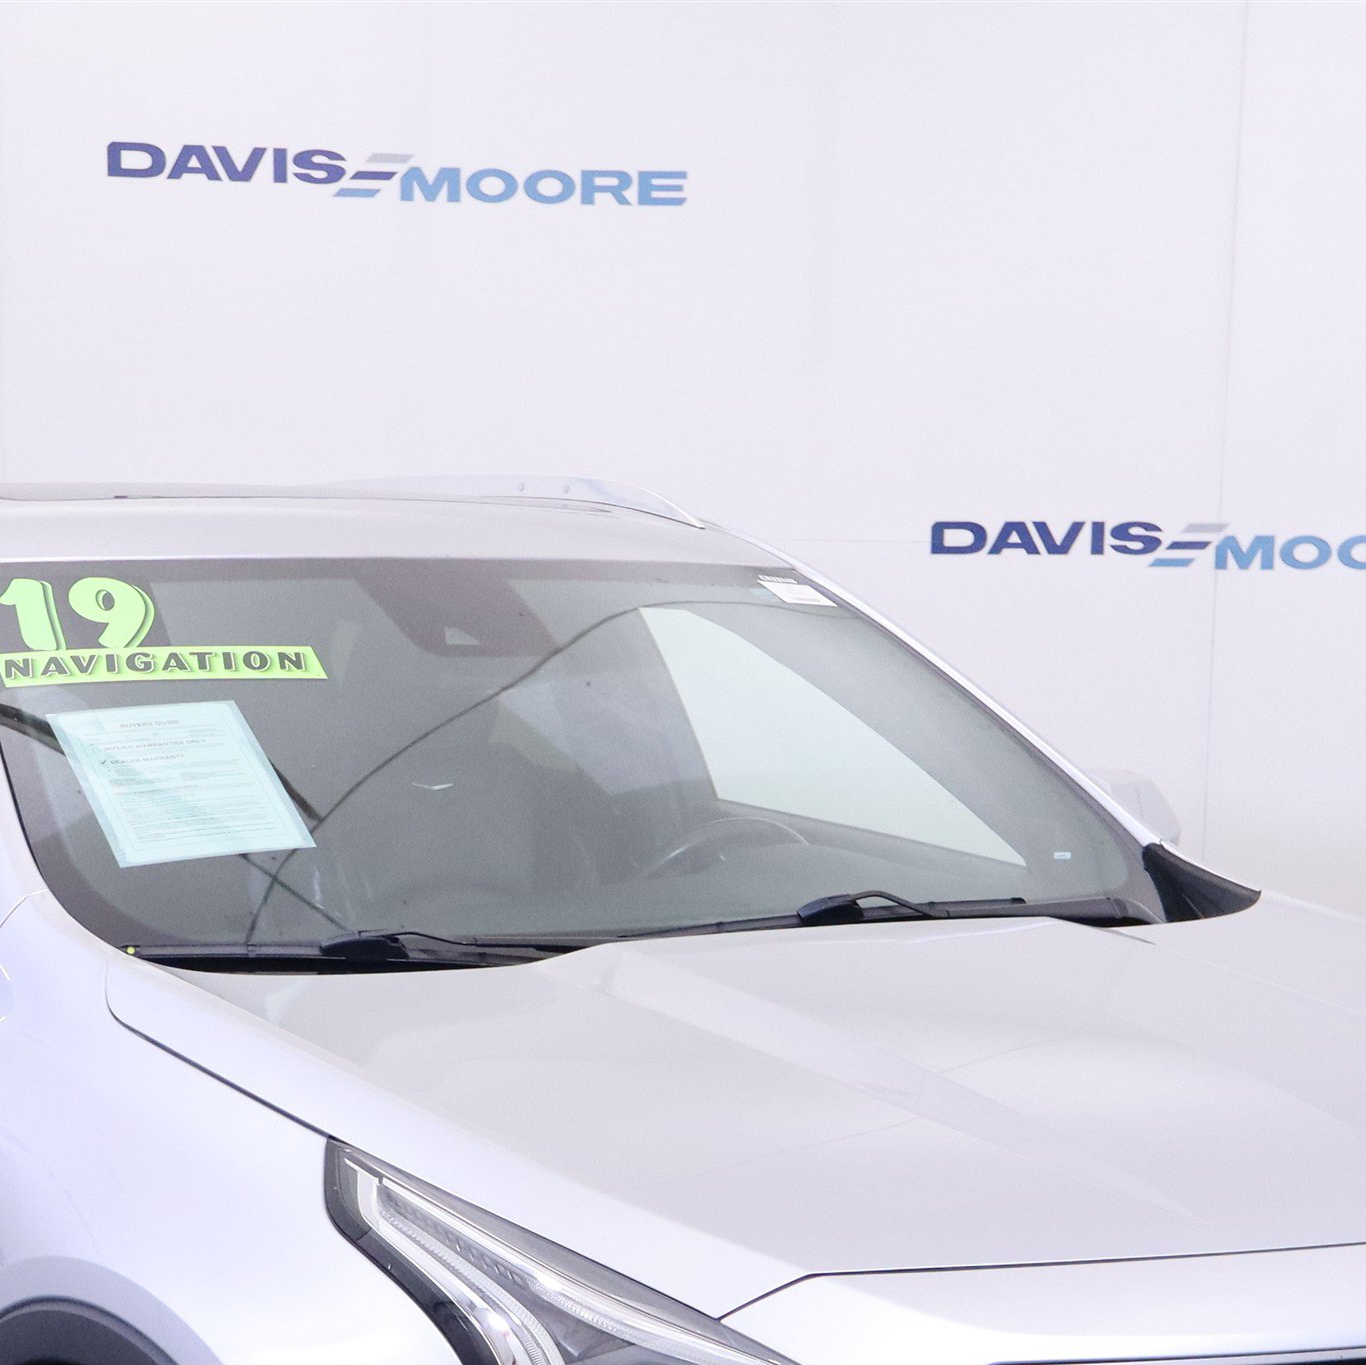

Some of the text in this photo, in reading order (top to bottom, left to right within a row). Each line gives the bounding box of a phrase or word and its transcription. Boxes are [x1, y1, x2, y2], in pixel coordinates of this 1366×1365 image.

[107, 141, 688, 207] DAVIS MOORE
[930, 521, 1162, 556] DAVIS
[4, 651, 306, 679] NAVIGATION
